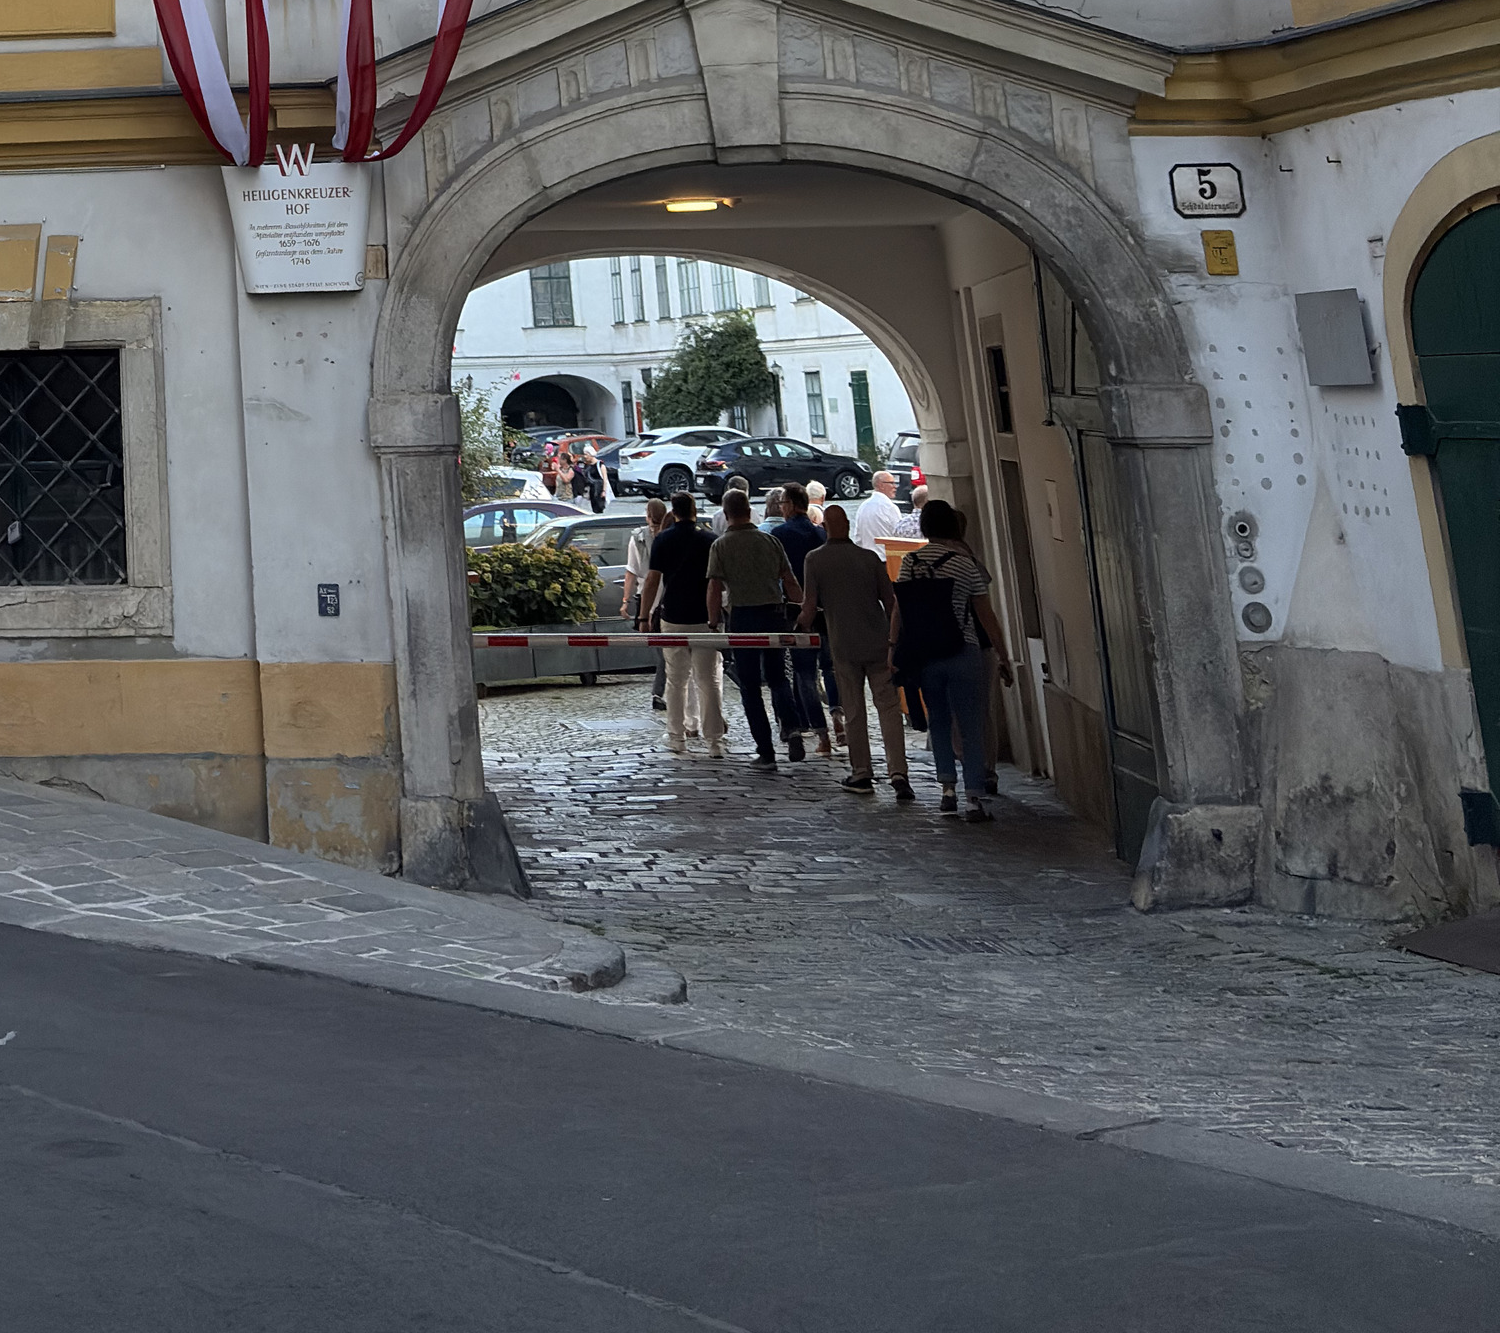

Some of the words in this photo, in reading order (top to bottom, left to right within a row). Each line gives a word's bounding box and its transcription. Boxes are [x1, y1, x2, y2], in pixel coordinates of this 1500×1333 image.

[274, 142, 316, 177] W
[1197, 168, 1218, 201] 5
[242, 186, 355, 202] HEILIGENKREUZER-
[285, 203, 311, 215] HOF
[290, 257, 311, 265] 1746
